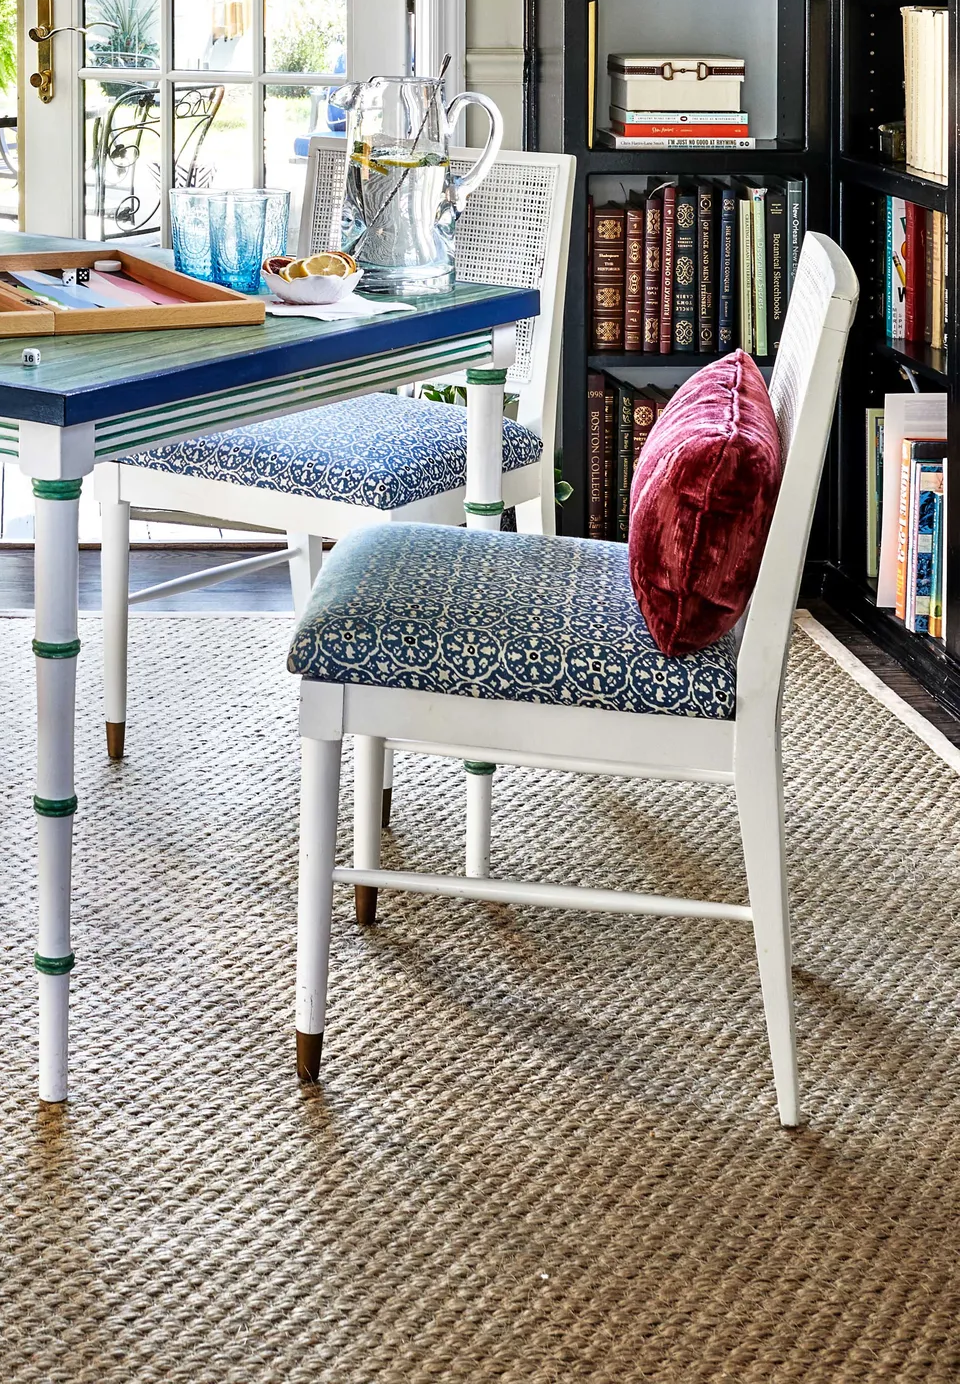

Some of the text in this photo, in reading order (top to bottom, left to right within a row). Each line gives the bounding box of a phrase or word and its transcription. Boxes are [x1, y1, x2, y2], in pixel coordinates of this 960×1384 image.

[664, 277, 671, 286] OF
[756, 242, 764, 282] Decorating
[773, 234, 781, 320] Botanical Sketchbooks
[24, 355, 34, 363] 16
[588, 391, 604, 399] 1998
[592, 411, 601, 503] BOSTON COLLEGE
[899, 466, 909, 516] HOME
